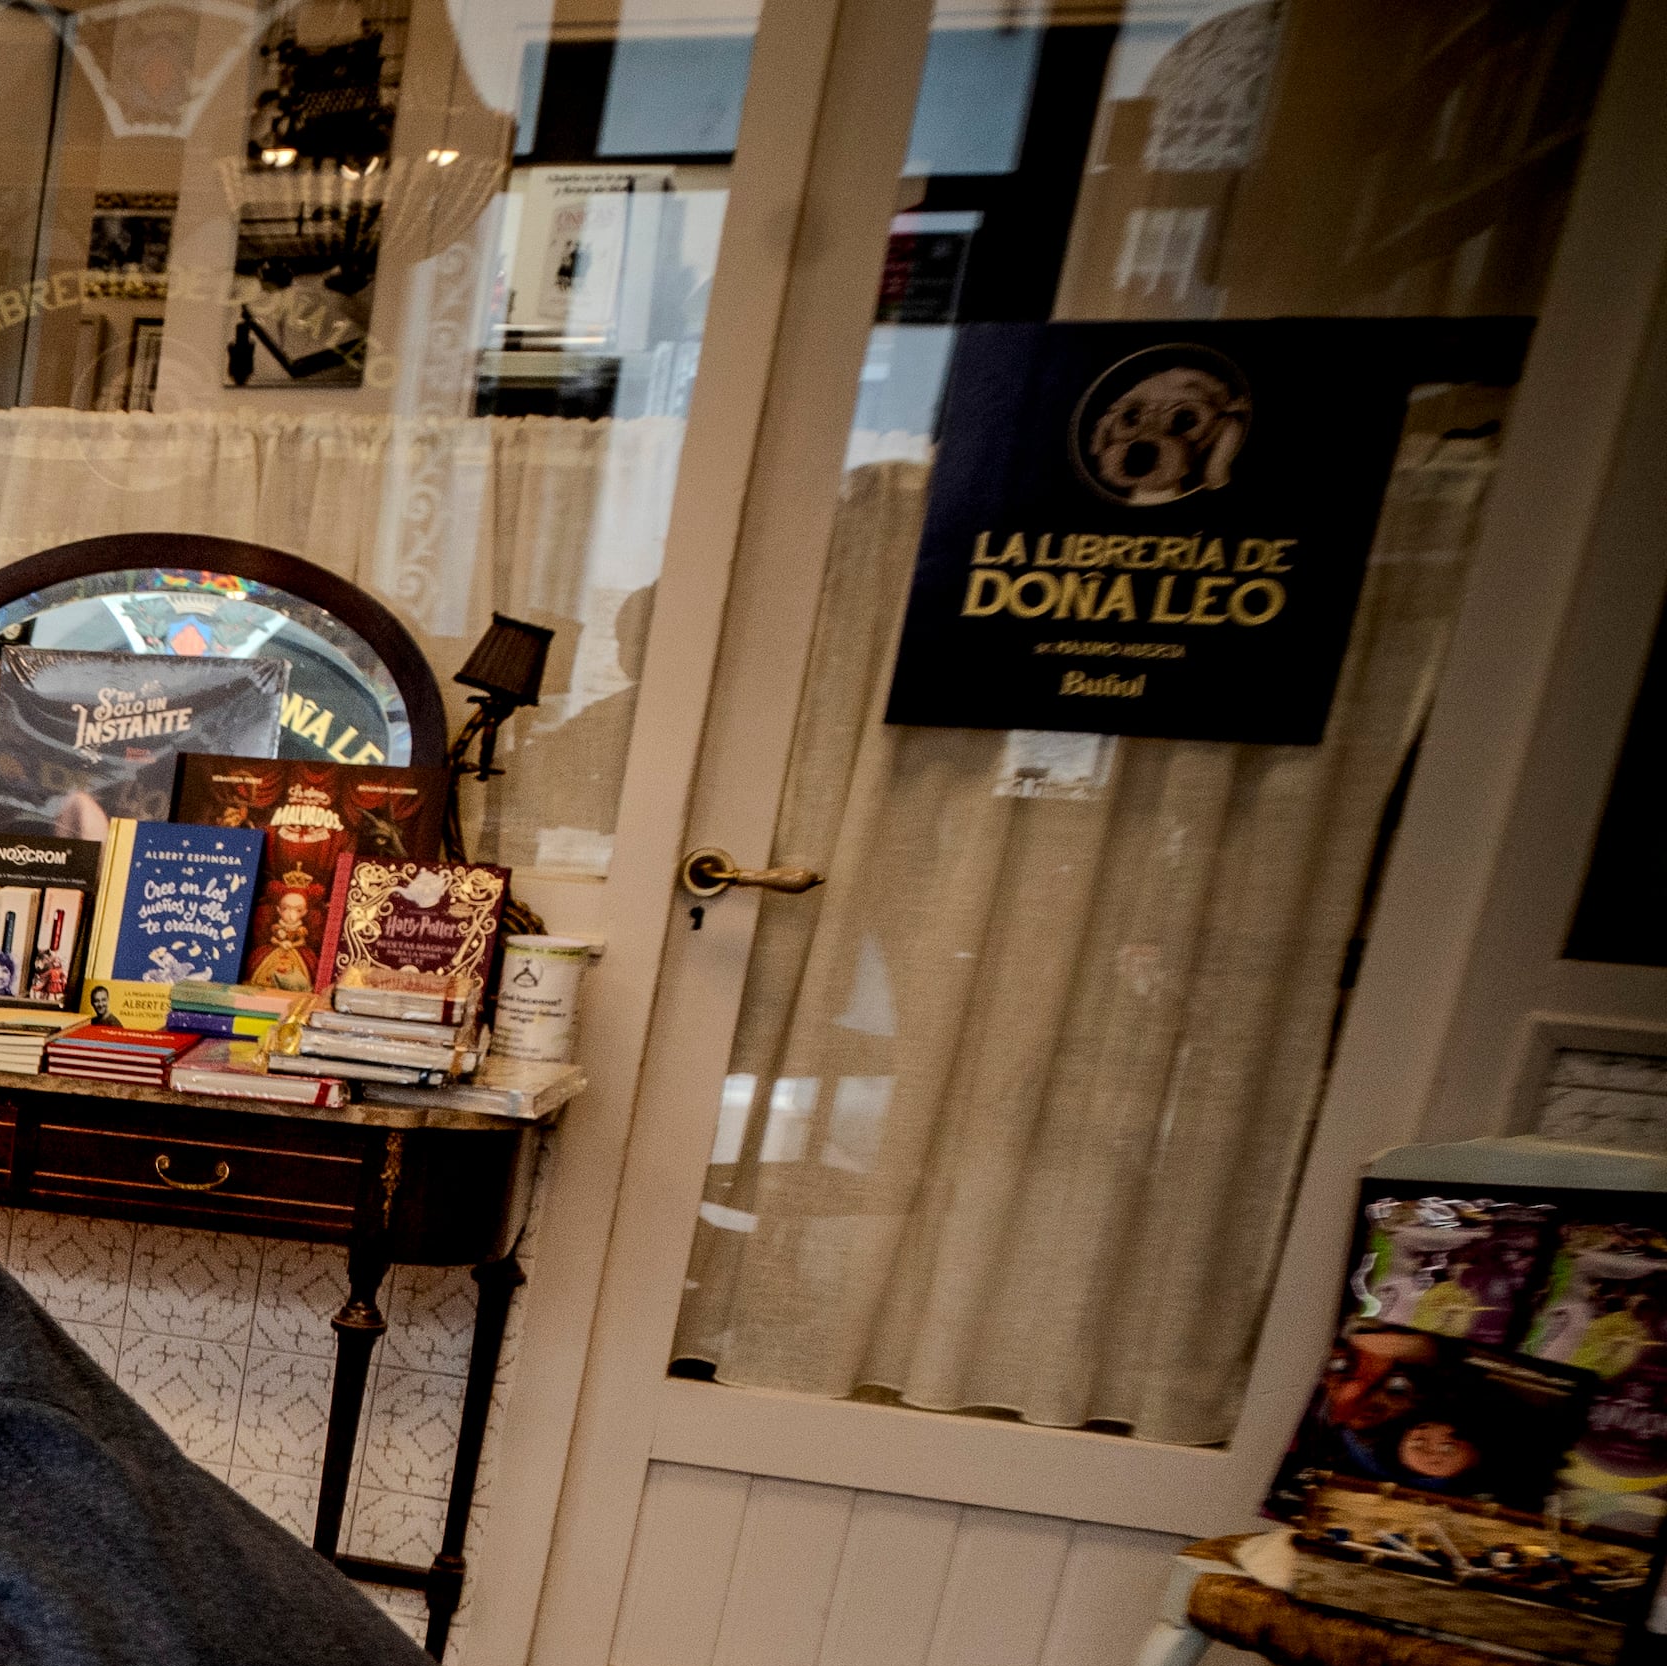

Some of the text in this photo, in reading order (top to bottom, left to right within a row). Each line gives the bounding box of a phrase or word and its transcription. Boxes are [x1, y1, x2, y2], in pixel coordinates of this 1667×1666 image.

[71, 704, 193, 750] INSTANTE
[144, 851, 242, 866] ALBERT ESPINOSA
[144, 878, 228, 901] Cree en los
[138, 898, 232, 925] sueños y ellos
[138, 919, 220, 941] te crearán
[385, 915, 458, 938] Harry Potter
